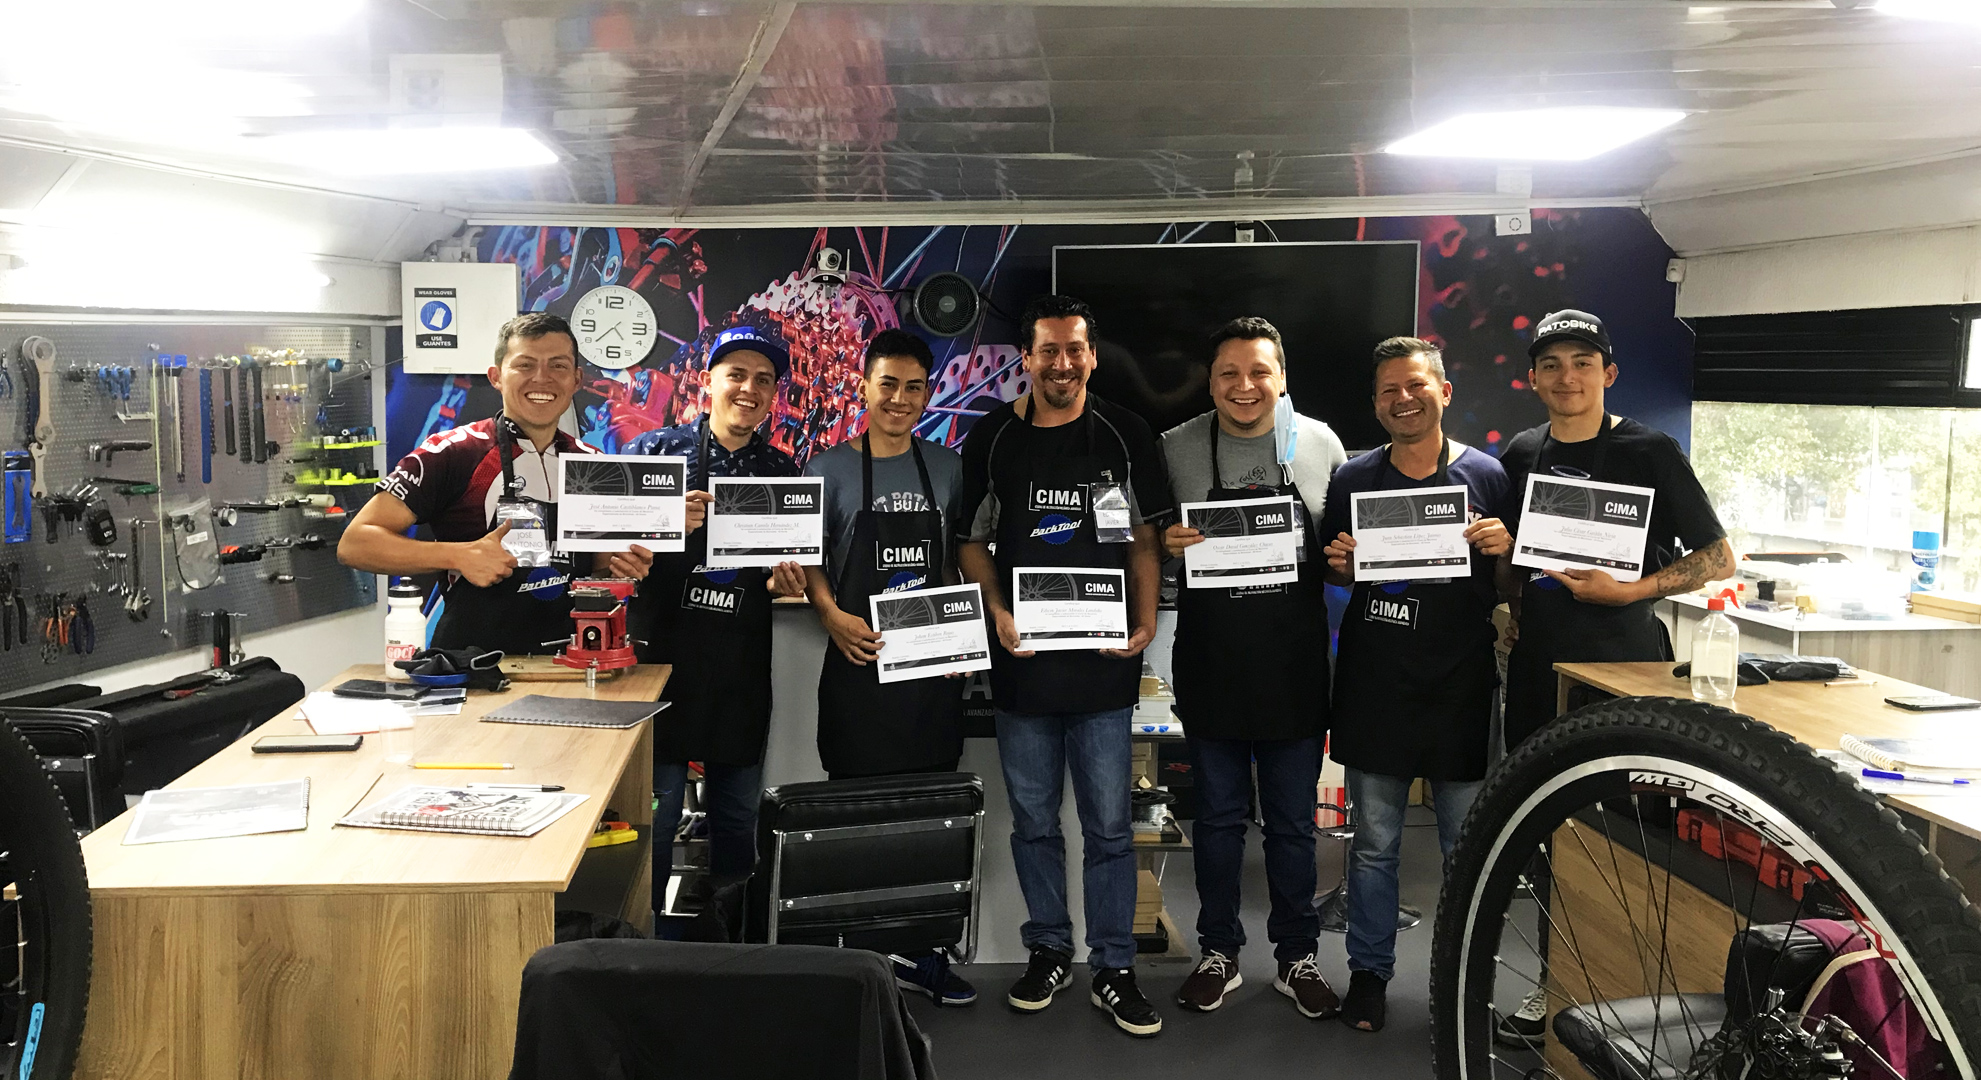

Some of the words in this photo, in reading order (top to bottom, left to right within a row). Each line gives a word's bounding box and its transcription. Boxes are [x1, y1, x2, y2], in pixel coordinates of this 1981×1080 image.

[606, 296, 624, 309] 12
[581, 319, 596, 332] 9
[632, 322, 647, 335] 3
[1538, 320, 1598, 336] PATOBIKE
[606, 346, 621, 358] 6
[642, 474, 675, 486] CIMA
[783, 494, 813, 504] CIMA
[1036, 489, 1081, 506] CIMA
[1425, 504, 1456, 516] CIMA
[1605, 502, 1638, 516] CIMA
[1256, 514, 1284, 525] CIMA
[883, 547, 924, 563] CIMA
[1085, 583, 1115, 593] CIMA
[690, 587, 734, 608] CIMA
[943, 601, 973, 614] CIMA
[1370, 599, 1410, 620] CIMA
